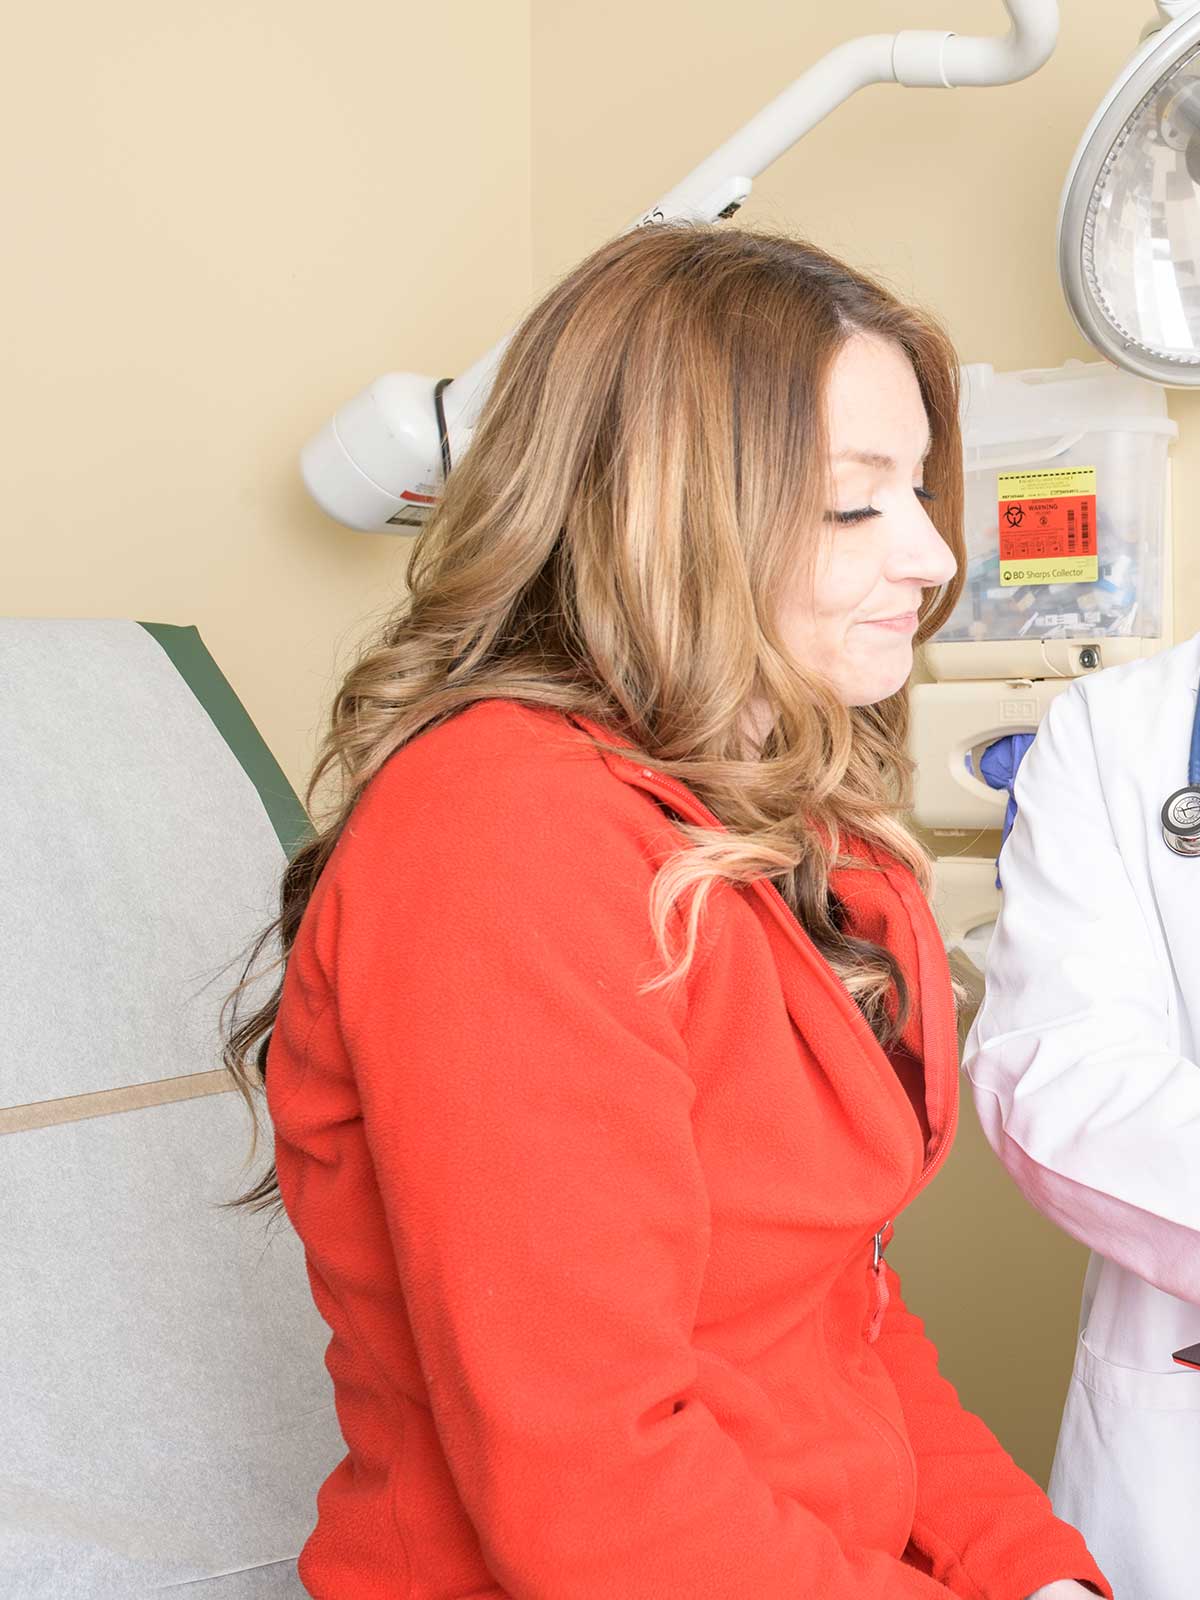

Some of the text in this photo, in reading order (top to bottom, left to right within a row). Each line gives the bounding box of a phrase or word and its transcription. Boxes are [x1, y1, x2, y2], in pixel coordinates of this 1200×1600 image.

[1028, 503, 1058, 511] WARNING
[1013, 568, 1084, 579] BD Sharps Collector
